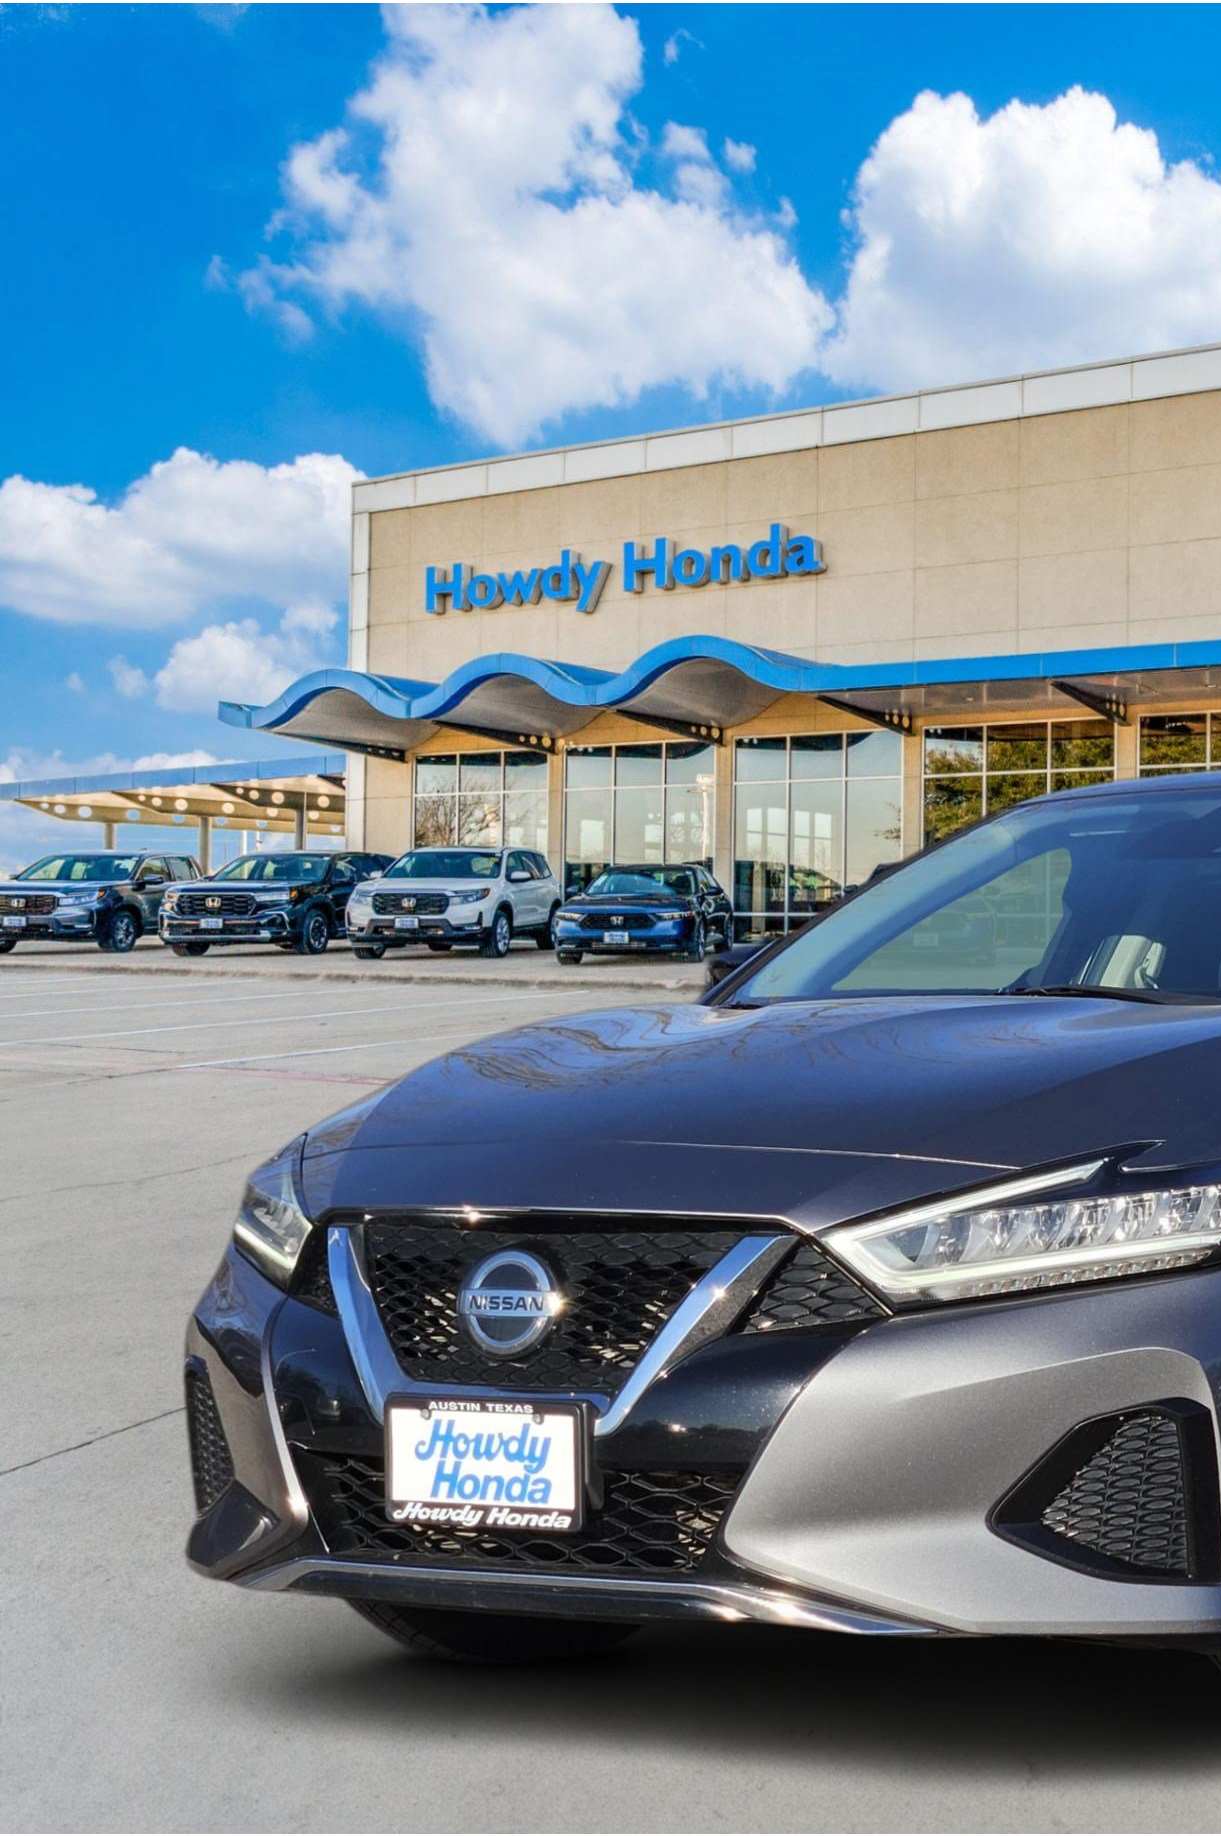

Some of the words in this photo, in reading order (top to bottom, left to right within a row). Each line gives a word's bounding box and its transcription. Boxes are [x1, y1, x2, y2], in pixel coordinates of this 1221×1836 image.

[425, 548, 612, 614] Howdy
[622, 522, 827, 594] Honda
[469, 1295, 545, 1312] NISSAN
[428, 1401, 480, 1412] AUSTIN
[485, 1402, 534, 1414] TEXAS
[414, 1419, 552, 1475] Howdy
[430, 1460, 552, 1504] Honda
[392, 1501, 484, 1527] Howdy
[486, 1506, 573, 1529] Honda
